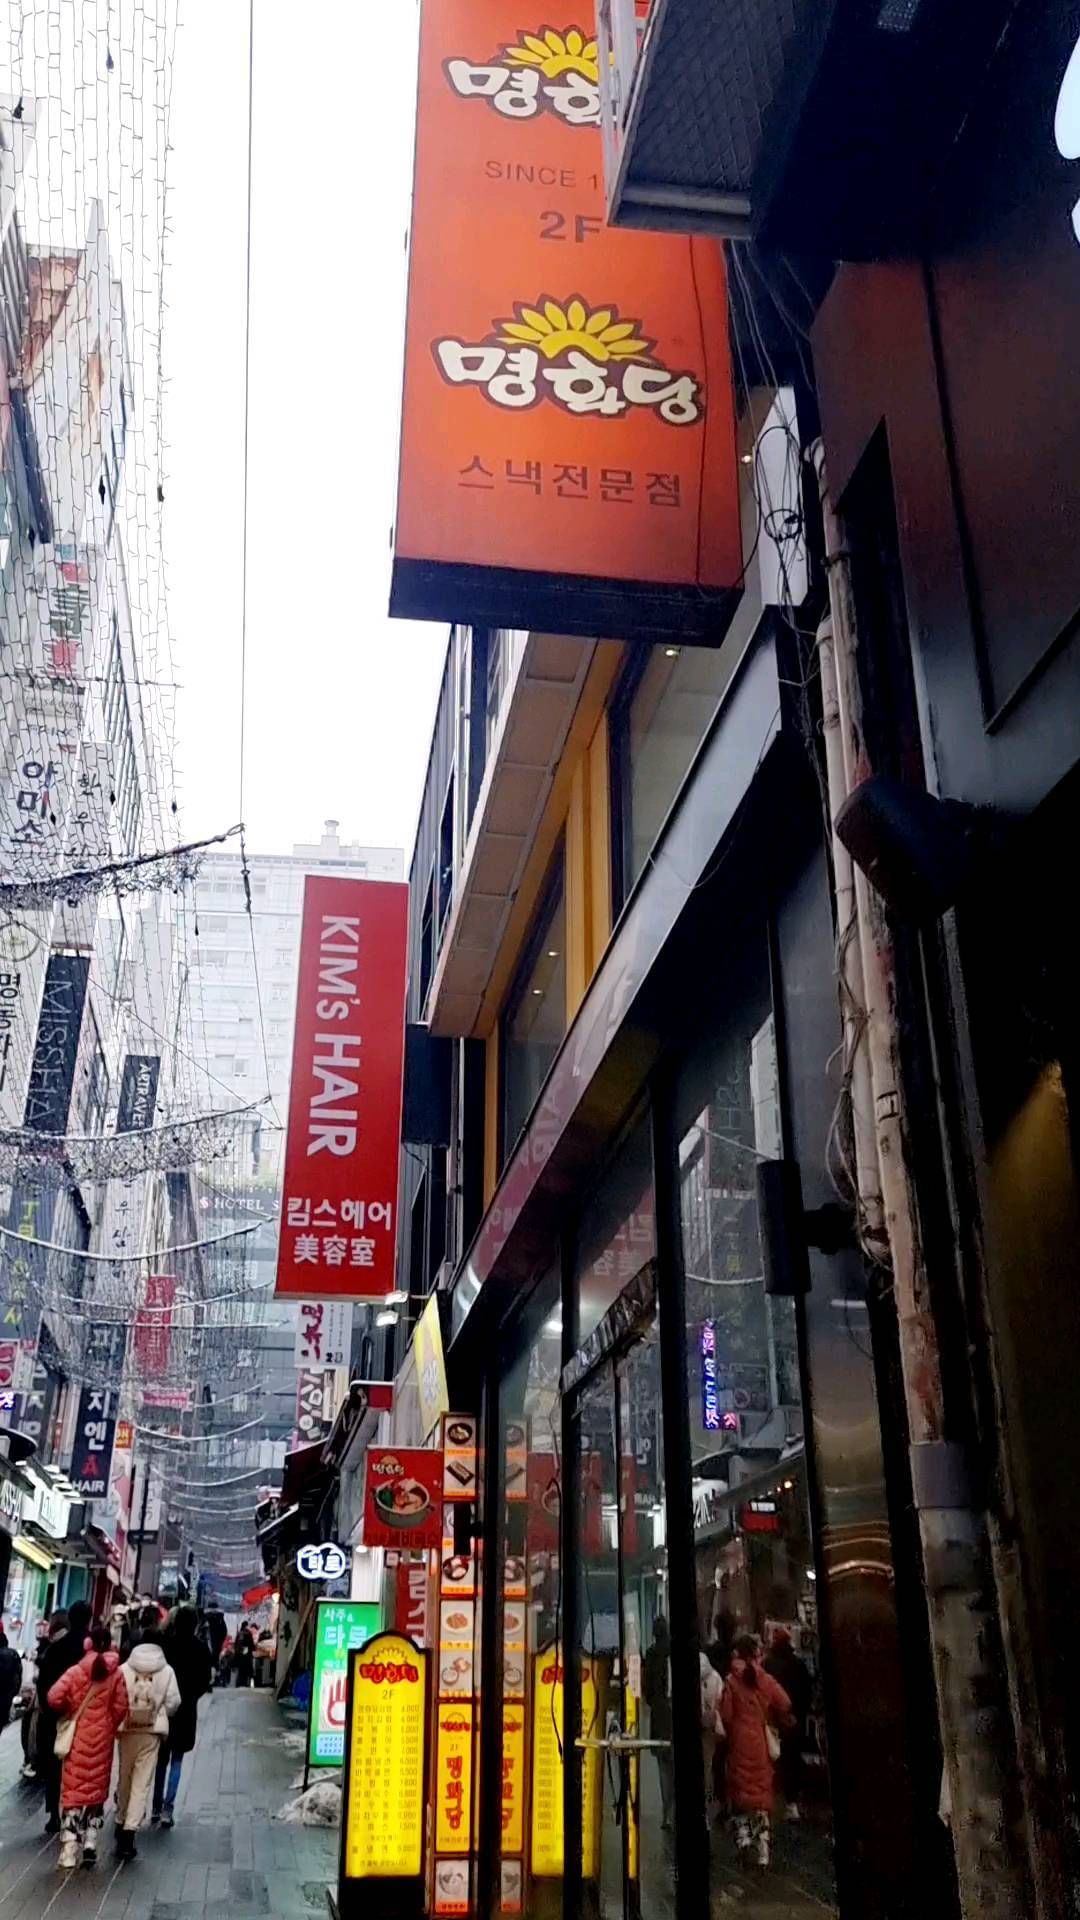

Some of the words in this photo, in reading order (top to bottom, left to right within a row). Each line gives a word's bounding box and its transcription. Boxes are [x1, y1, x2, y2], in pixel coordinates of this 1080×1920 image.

[449, 60, 603, 127] 명화
[484, 159, 577, 188] SINCE
[539, 209, 603, 243] 2F
[437, 340, 699, 425] 명화당
[457, 454, 682, 508] 스낵전문점
[27, 980, 74, 1122] MISSHA
[307, 1032, 362, 1158] HAIR
[214, 1197, 264, 1211] HOTEL
[287, 1197, 392, 1231] 킴스헤어
[293, 1233, 376, 1268] 美容室
[72, 1480, 105, 1493] HAIR
